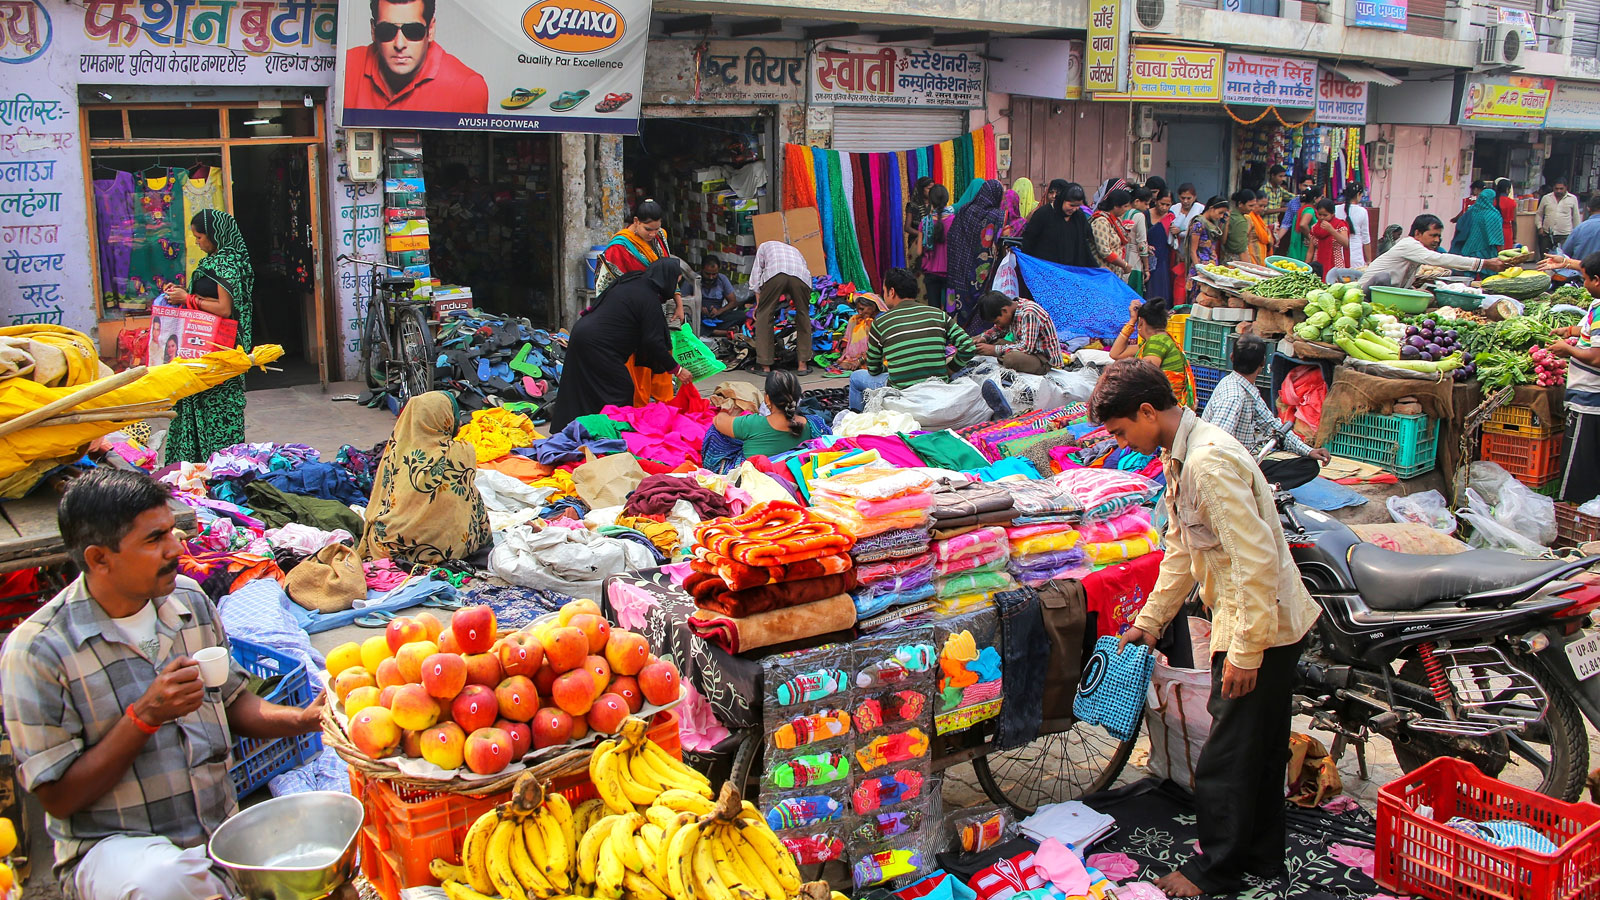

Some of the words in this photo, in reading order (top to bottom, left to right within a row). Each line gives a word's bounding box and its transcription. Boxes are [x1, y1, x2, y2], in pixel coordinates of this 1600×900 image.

[1356, 1, 1376, 16] पान
[532, 6, 617, 40] RELAXO
[1092, 36, 1115, 52] बाबा
[79, 54, 125, 73] रामनगर
[129, 50, 166, 76] पुलिया
[168, 51, 200, 75] केदार
[201, 54, 227, 73] नगर
[265, 50, 310, 74] शाहगंज
[517, 54, 553, 67] Quality
[554, 56, 571, 66] Par
[573, 57, 624, 69] Excellence
[744, 47, 805, 87] वियर
[816, 48, 898, 95] स्वाती
[910, 50, 968, 73] स्टेशनरी
[1136, 61, 1168, 78] बाबा
[898, 72, 967, 92] कम्युनिकेशन
[1282, 61, 1314, 86] सिंह
[1141, 84, 1157, 92] लाल
[1227, 80, 1252, 93] मान
[1252, 79, 1277, 95] देवी
[1319, 72, 1365, 99] दीपक
[1319, 101, 1335, 113] पान
[458, 118, 489, 127] AYUSH
[490, 119, 540, 129] FOOTWEAR
[2, 225, 62, 244] गाउन
[19, 283, 61, 307] सूट
[863, 609, 904, 628] MOTORCYCLE
[905, 604, 929, 615] SERIES
